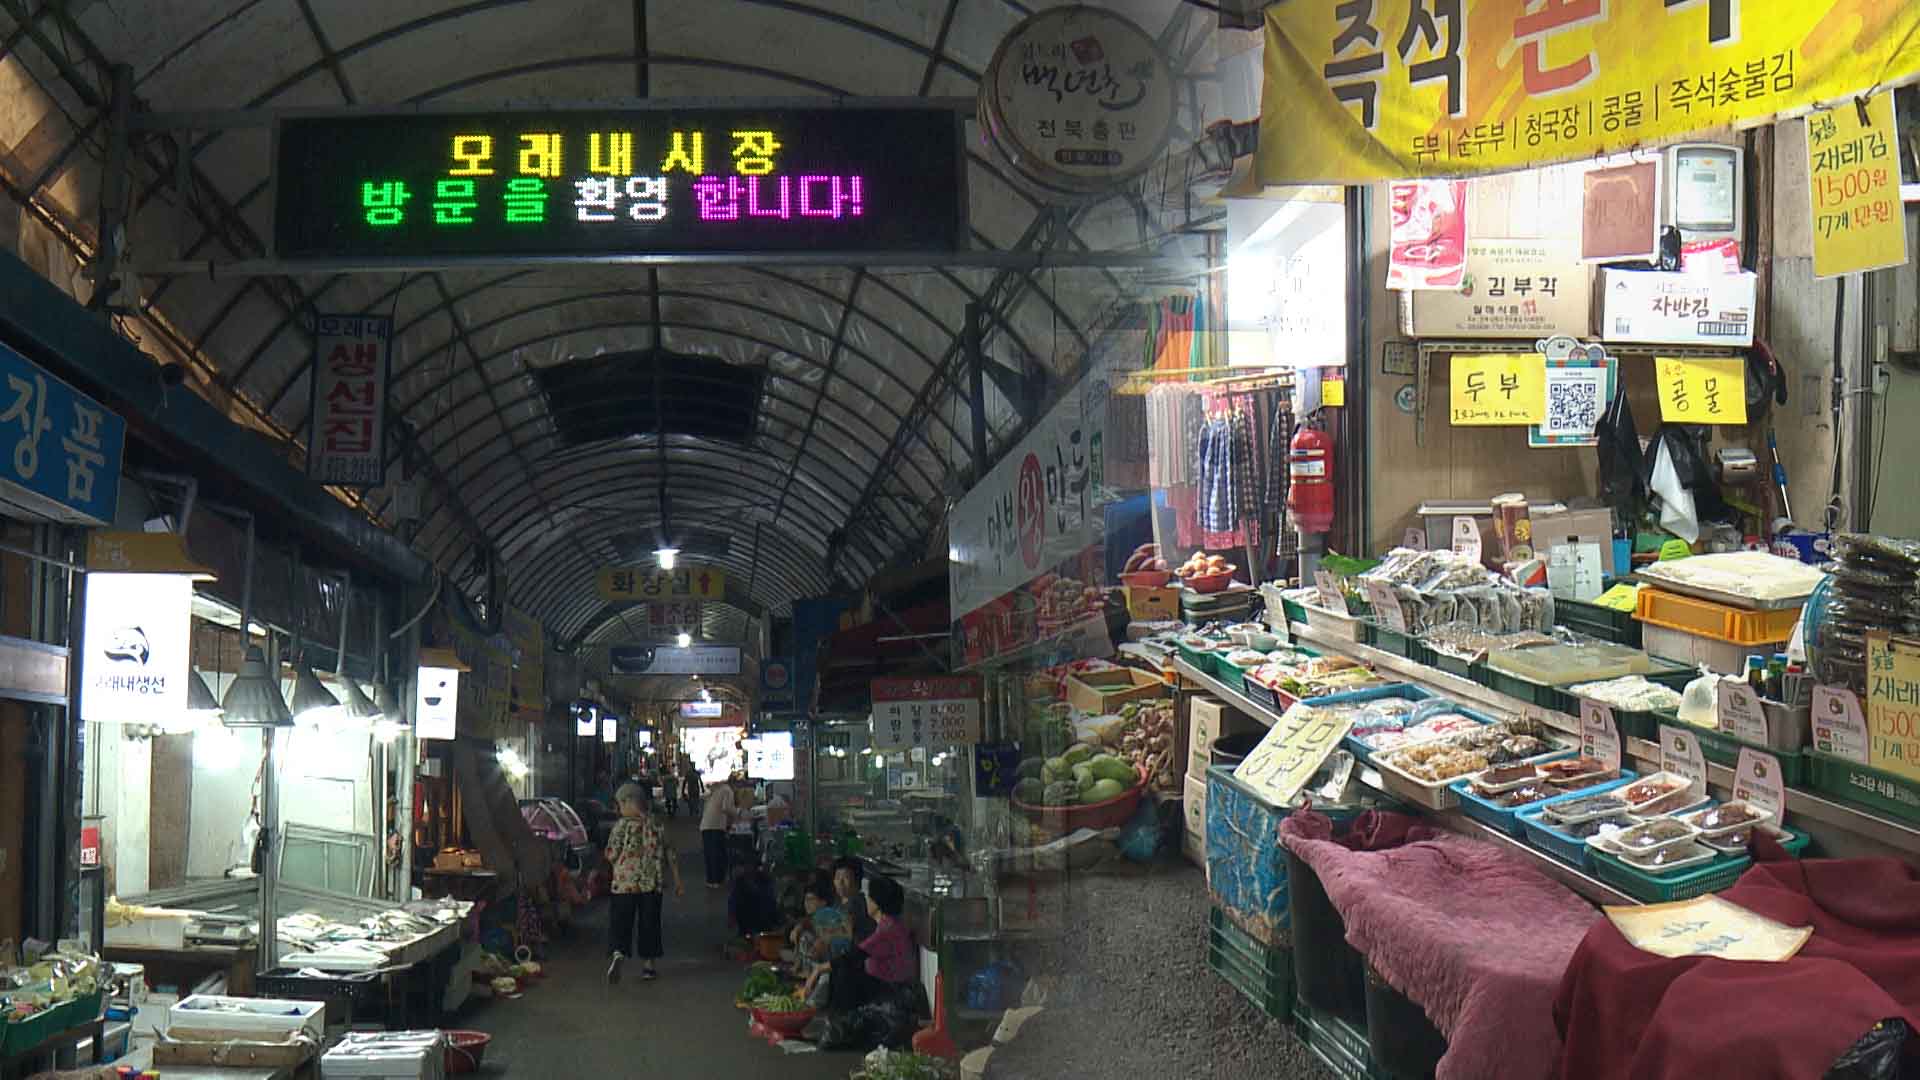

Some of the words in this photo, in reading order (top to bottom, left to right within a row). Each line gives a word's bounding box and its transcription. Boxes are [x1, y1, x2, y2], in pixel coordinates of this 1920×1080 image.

[1324, 0, 1461, 129] 즉석
[1411, 135, 1441, 165] 두부
[1456, 120, 1506, 159] 순두부
[1524, 103, 1581, 148] 청국장
[1601, 90, 1645, 134] 콩물
[1669, 49, 1796, 114] 즉석숯불김
[1812, 130, 1889, 174] 재래김
[573, 176, 669, 223] 환영
[692, 175, 864, 222] 합니다!
[1814, 167, 1889, 209] 1500원
[1487, 276, 1559, 297] 김부각
[1652, 295, 1711, 320] 자반김
[325, 342, 377, 454] 생선집
[1464, 371, 1520, 402] 두부
[1671, 376, 1723, 415] 콩물
